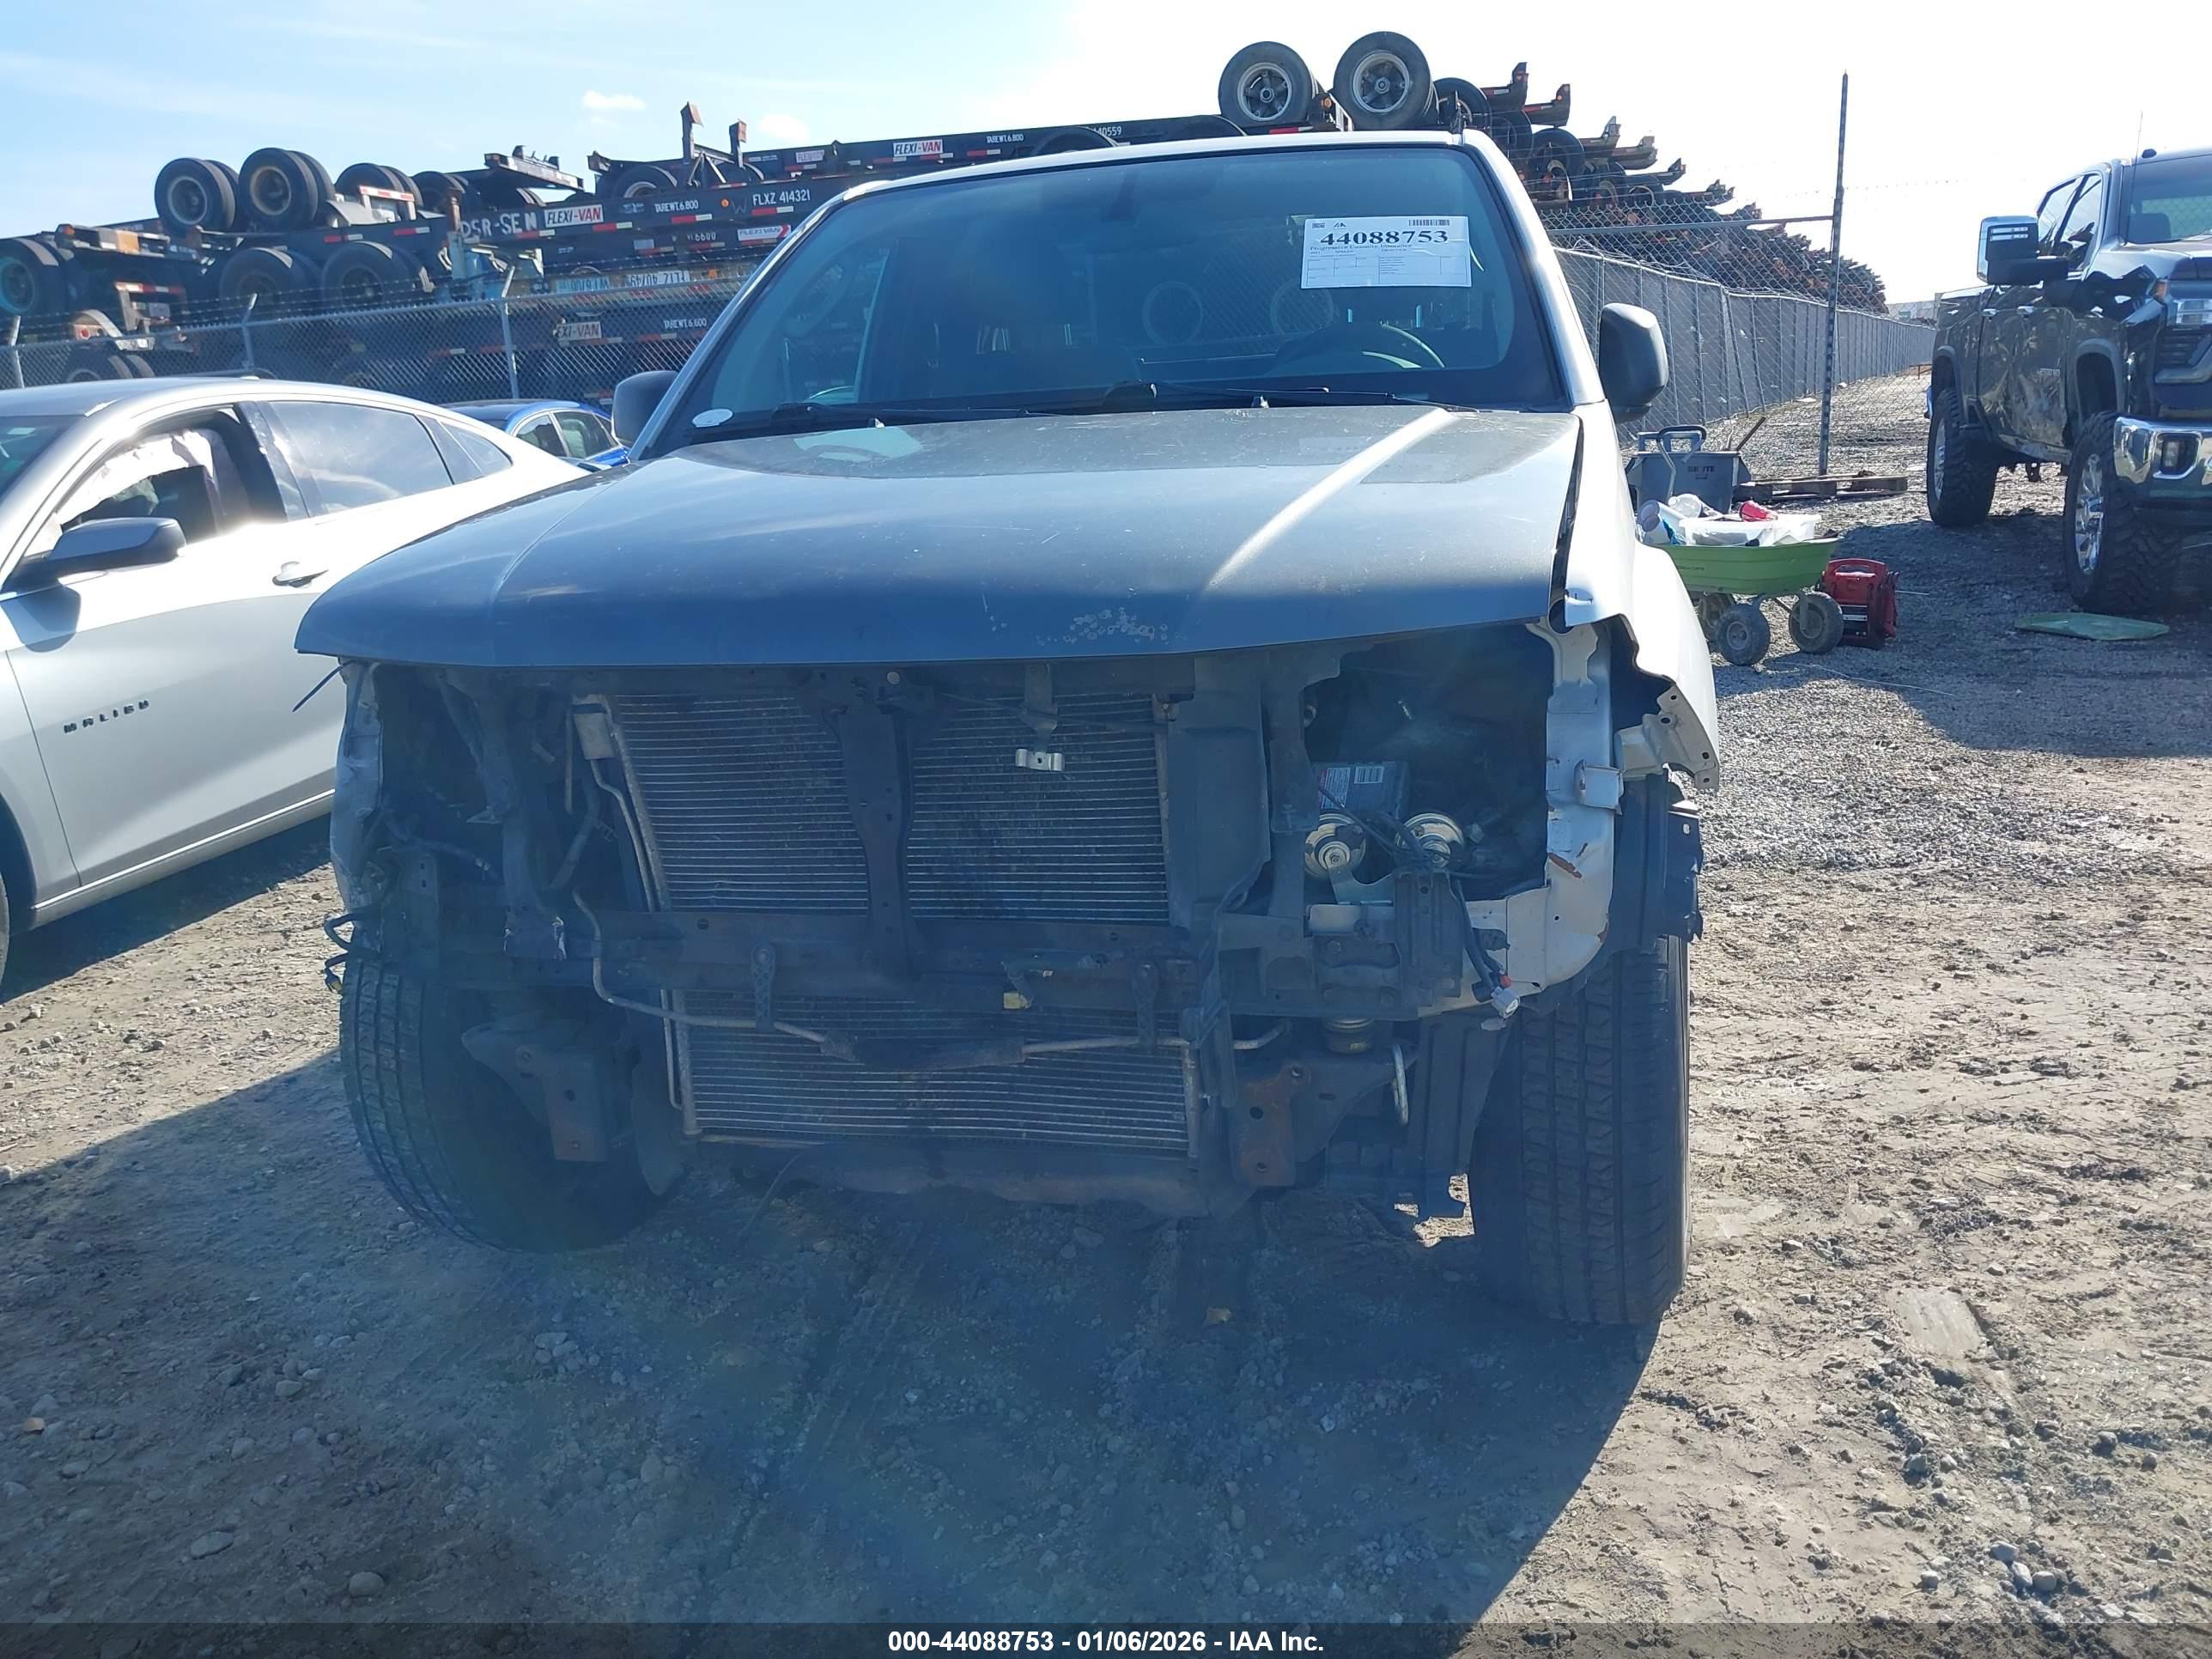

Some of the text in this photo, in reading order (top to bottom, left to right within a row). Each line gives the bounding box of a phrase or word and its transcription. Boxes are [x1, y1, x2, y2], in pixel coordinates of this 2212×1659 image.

[752, 189, 811, 207] FLXZ 414321
[547, 207, 601, 225] FLEXI-VAN
[1320, 230, 1449, 246] 44088753
[64, 700, 149, 734] MALIBU
